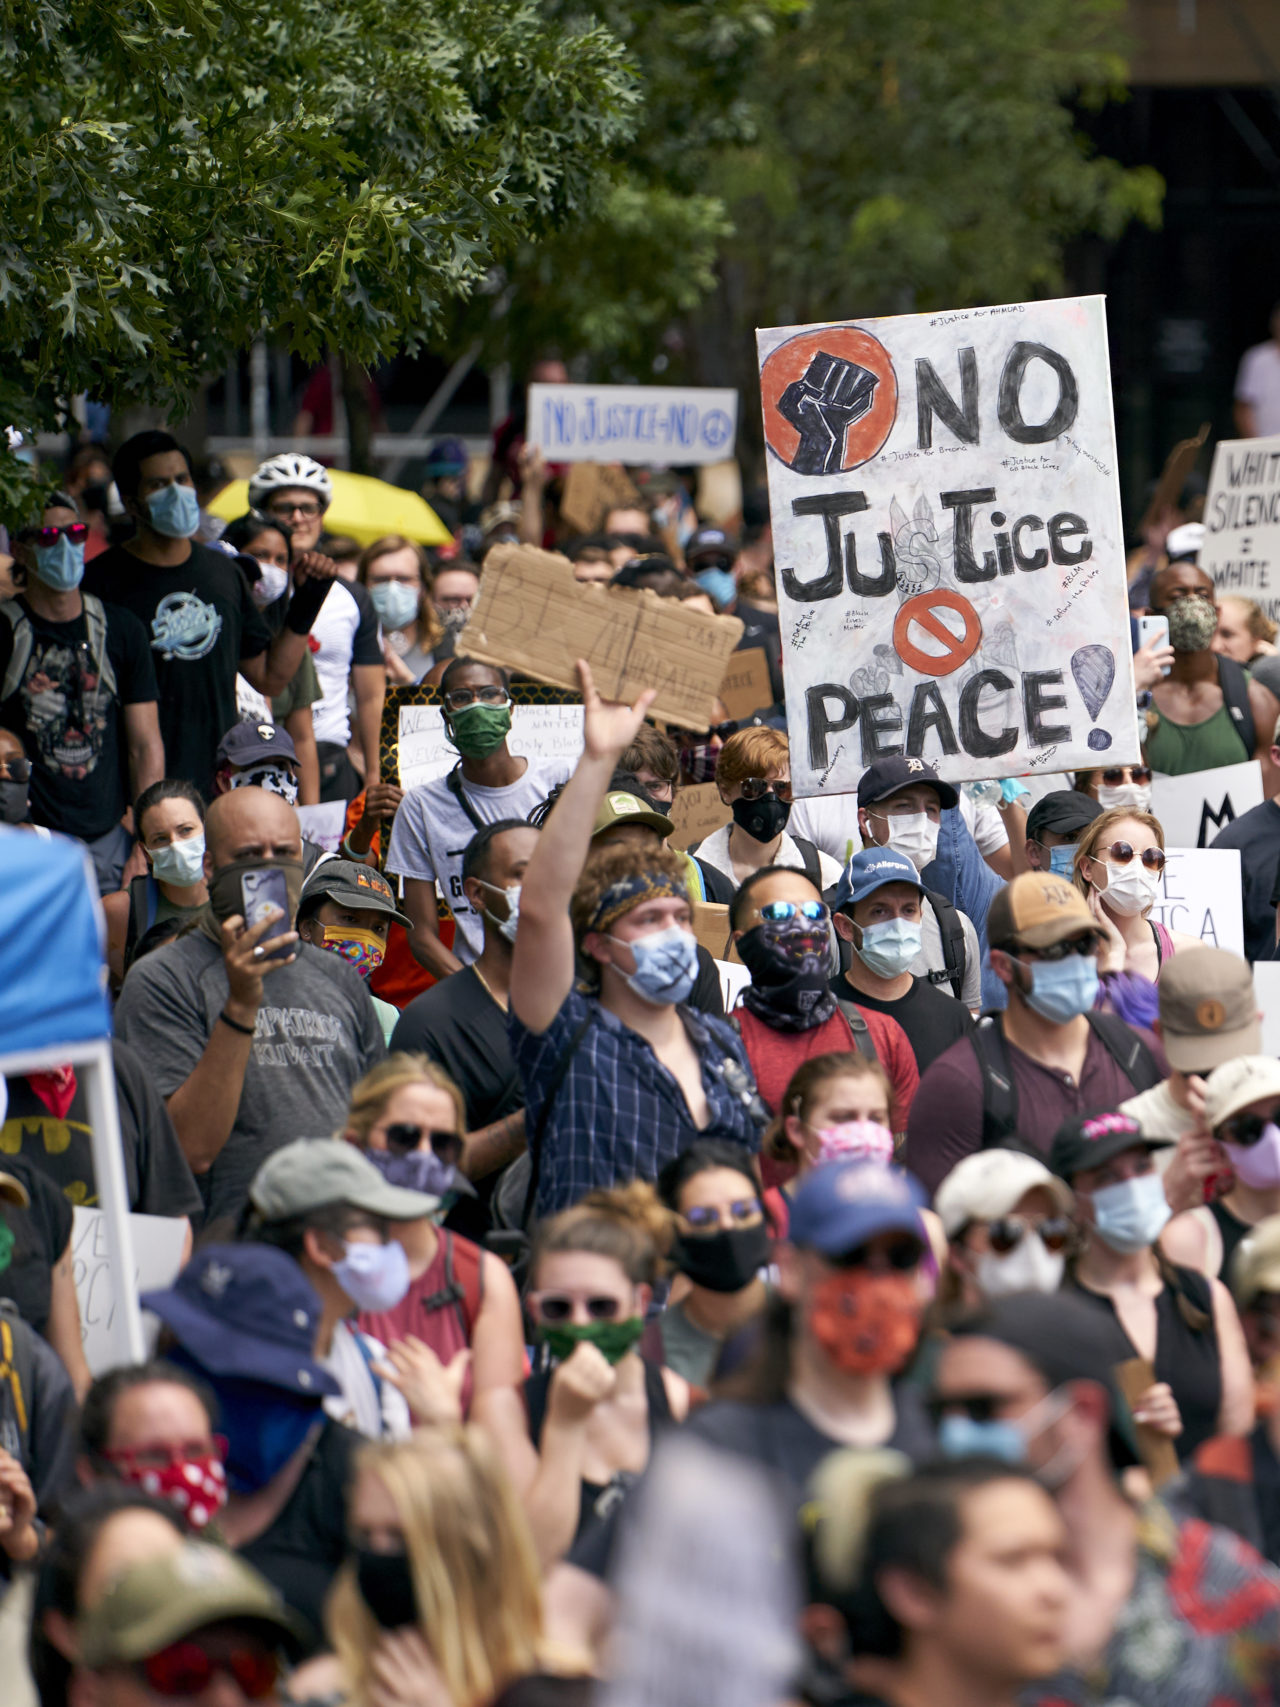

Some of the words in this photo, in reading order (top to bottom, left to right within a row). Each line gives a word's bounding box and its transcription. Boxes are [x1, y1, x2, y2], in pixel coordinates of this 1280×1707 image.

[914, 341, 1079, 450] NO
[1211, 561, 1271, 589] WHITE
[804, 644, 1115, 771] PEACE!
